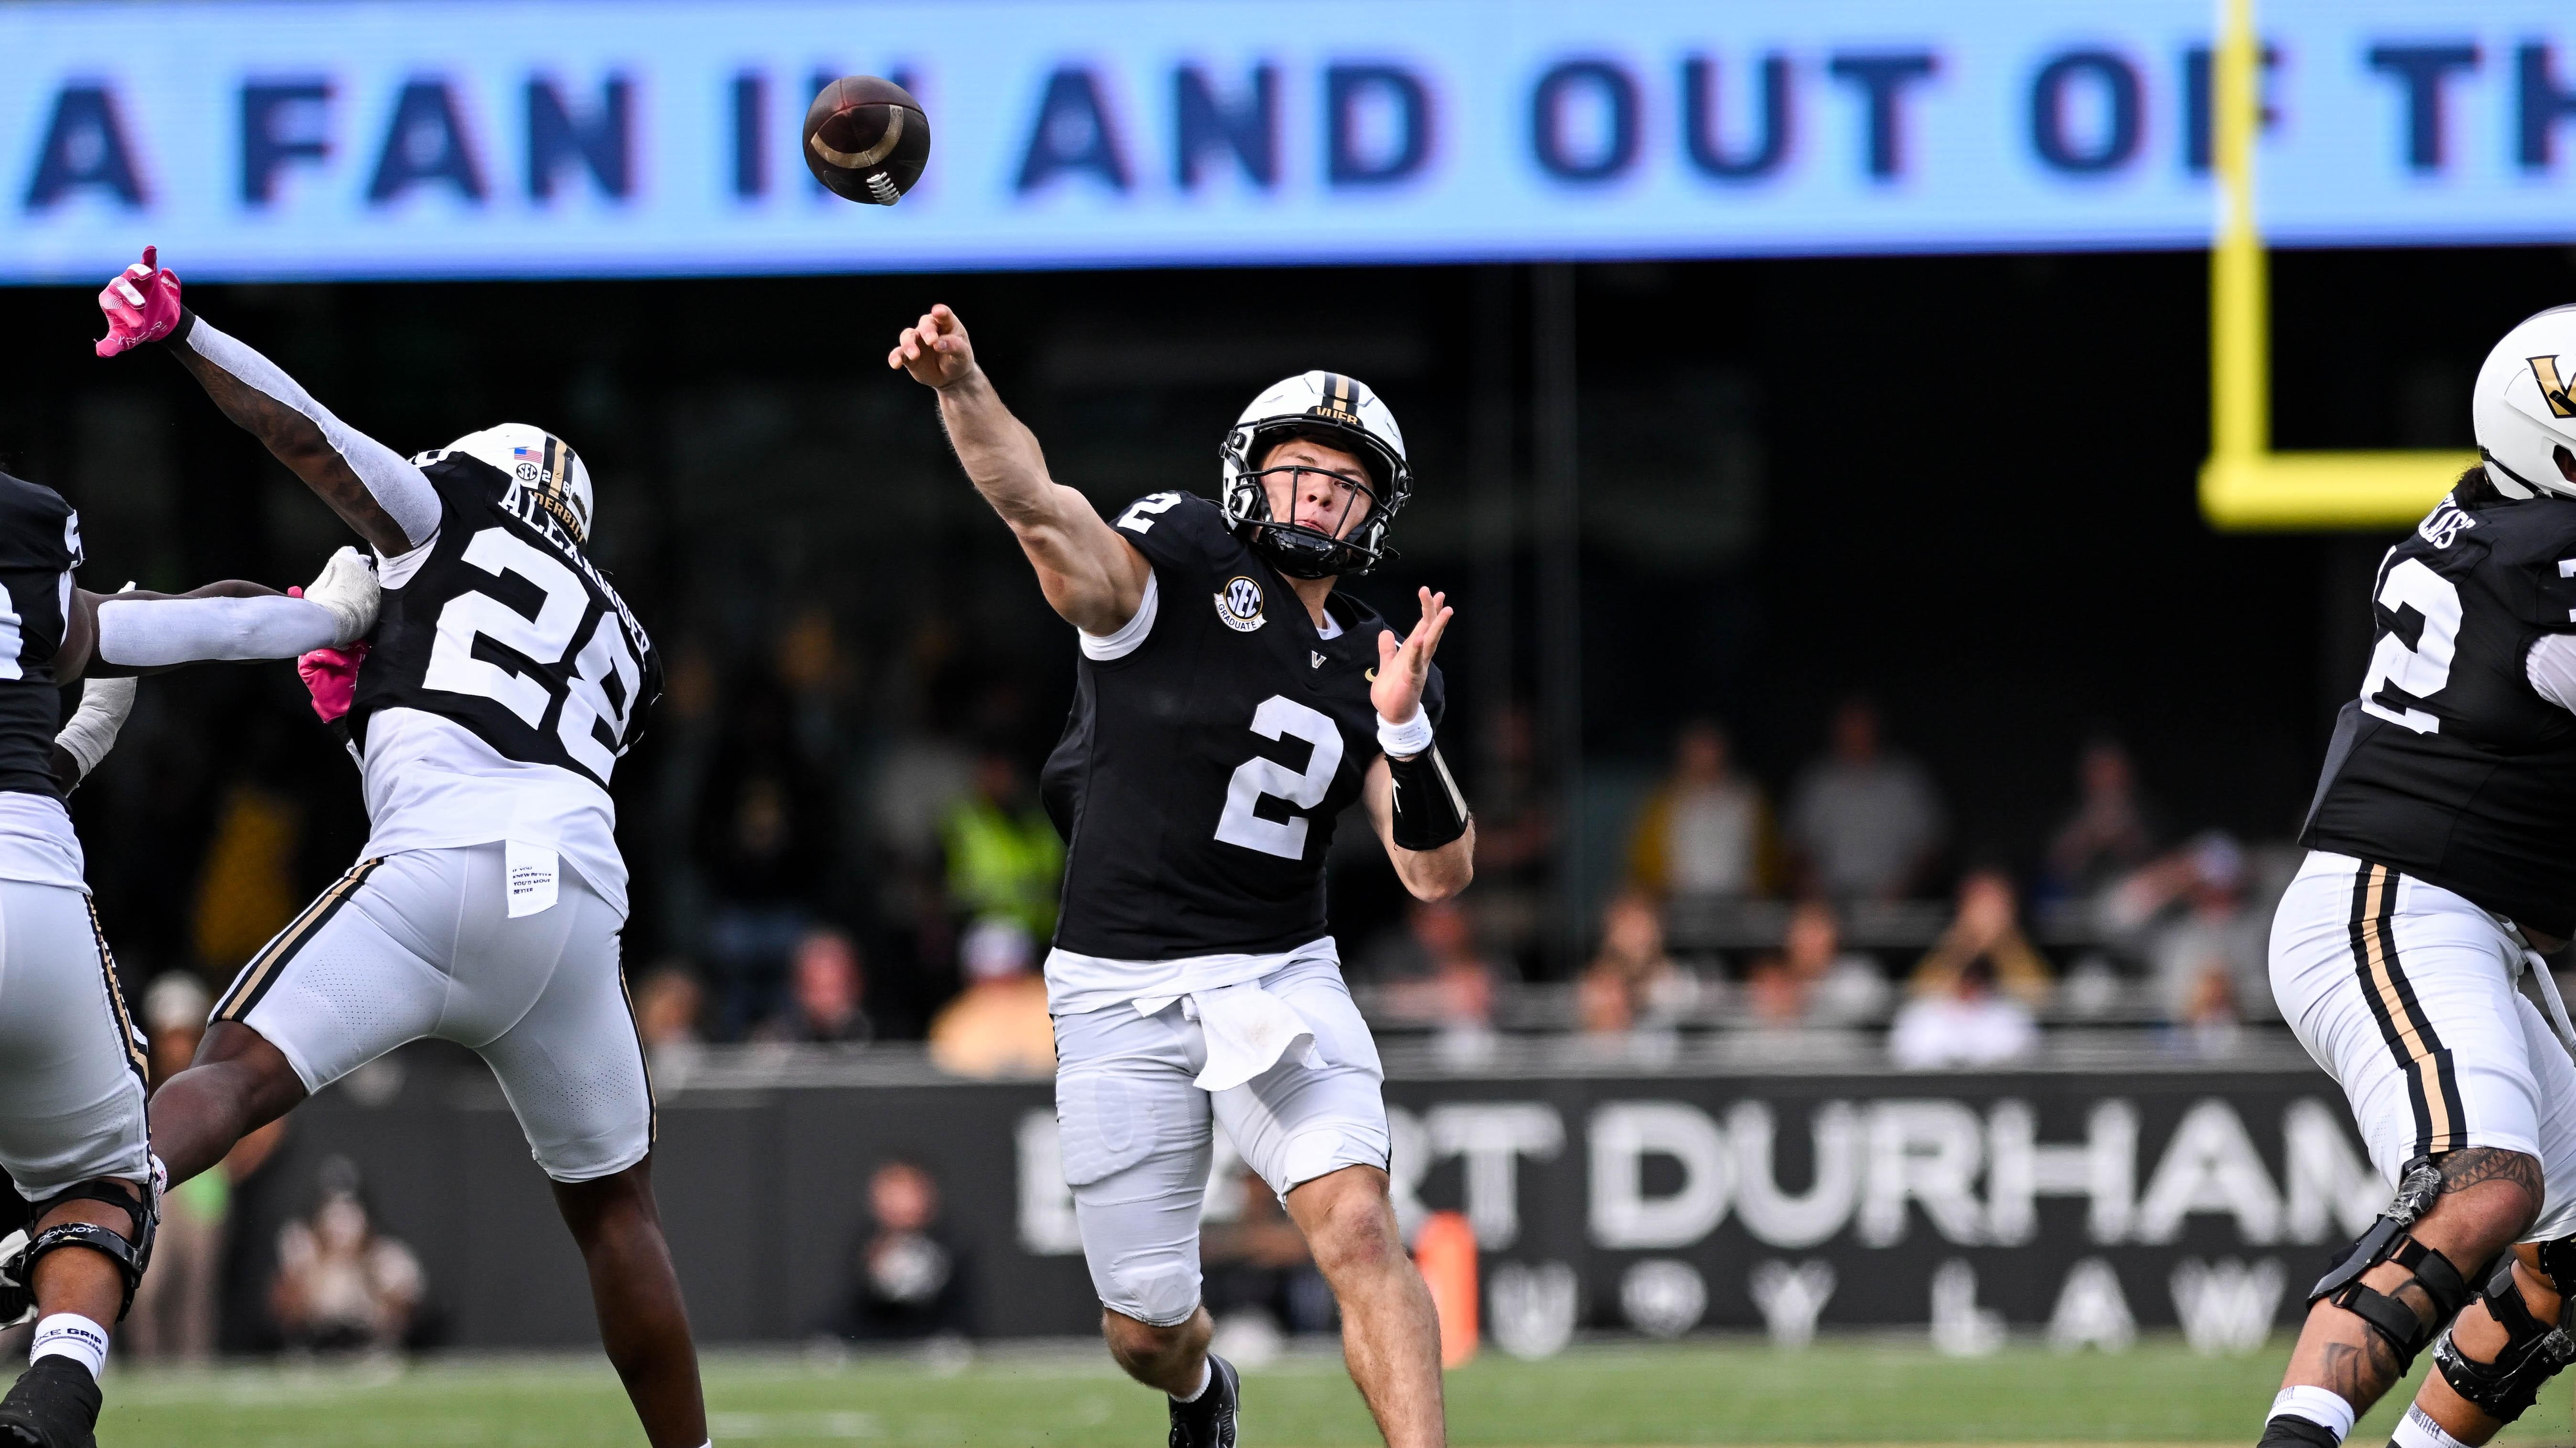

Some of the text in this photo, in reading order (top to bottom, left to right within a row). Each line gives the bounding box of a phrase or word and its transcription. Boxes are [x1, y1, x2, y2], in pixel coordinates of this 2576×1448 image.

[25, 80, 147, 208] A
[239, 72, 636, 206] FAN
[1015, 63, 1435, 192] AND
[1530, 54, 1939, 183] OUT
[517, 465, 537, 480] SEC
[541, 470, 551, 482] 2
[1117, 492, 1182, 535] 2
[1218, 603, 1258, 631] GRADUATE
[1227, 579, 1261, 618] SEC
[422, 526, 640, 787] 28
[2360, 545, 2464, 735] 2
[1214, 694, 1344, 861] 2
[1586, 1096, 2402, 1249] DURHAM
[67, 1327, 102, 1344] GRIP
[1928, 1255, 2291, 1358] LAW
